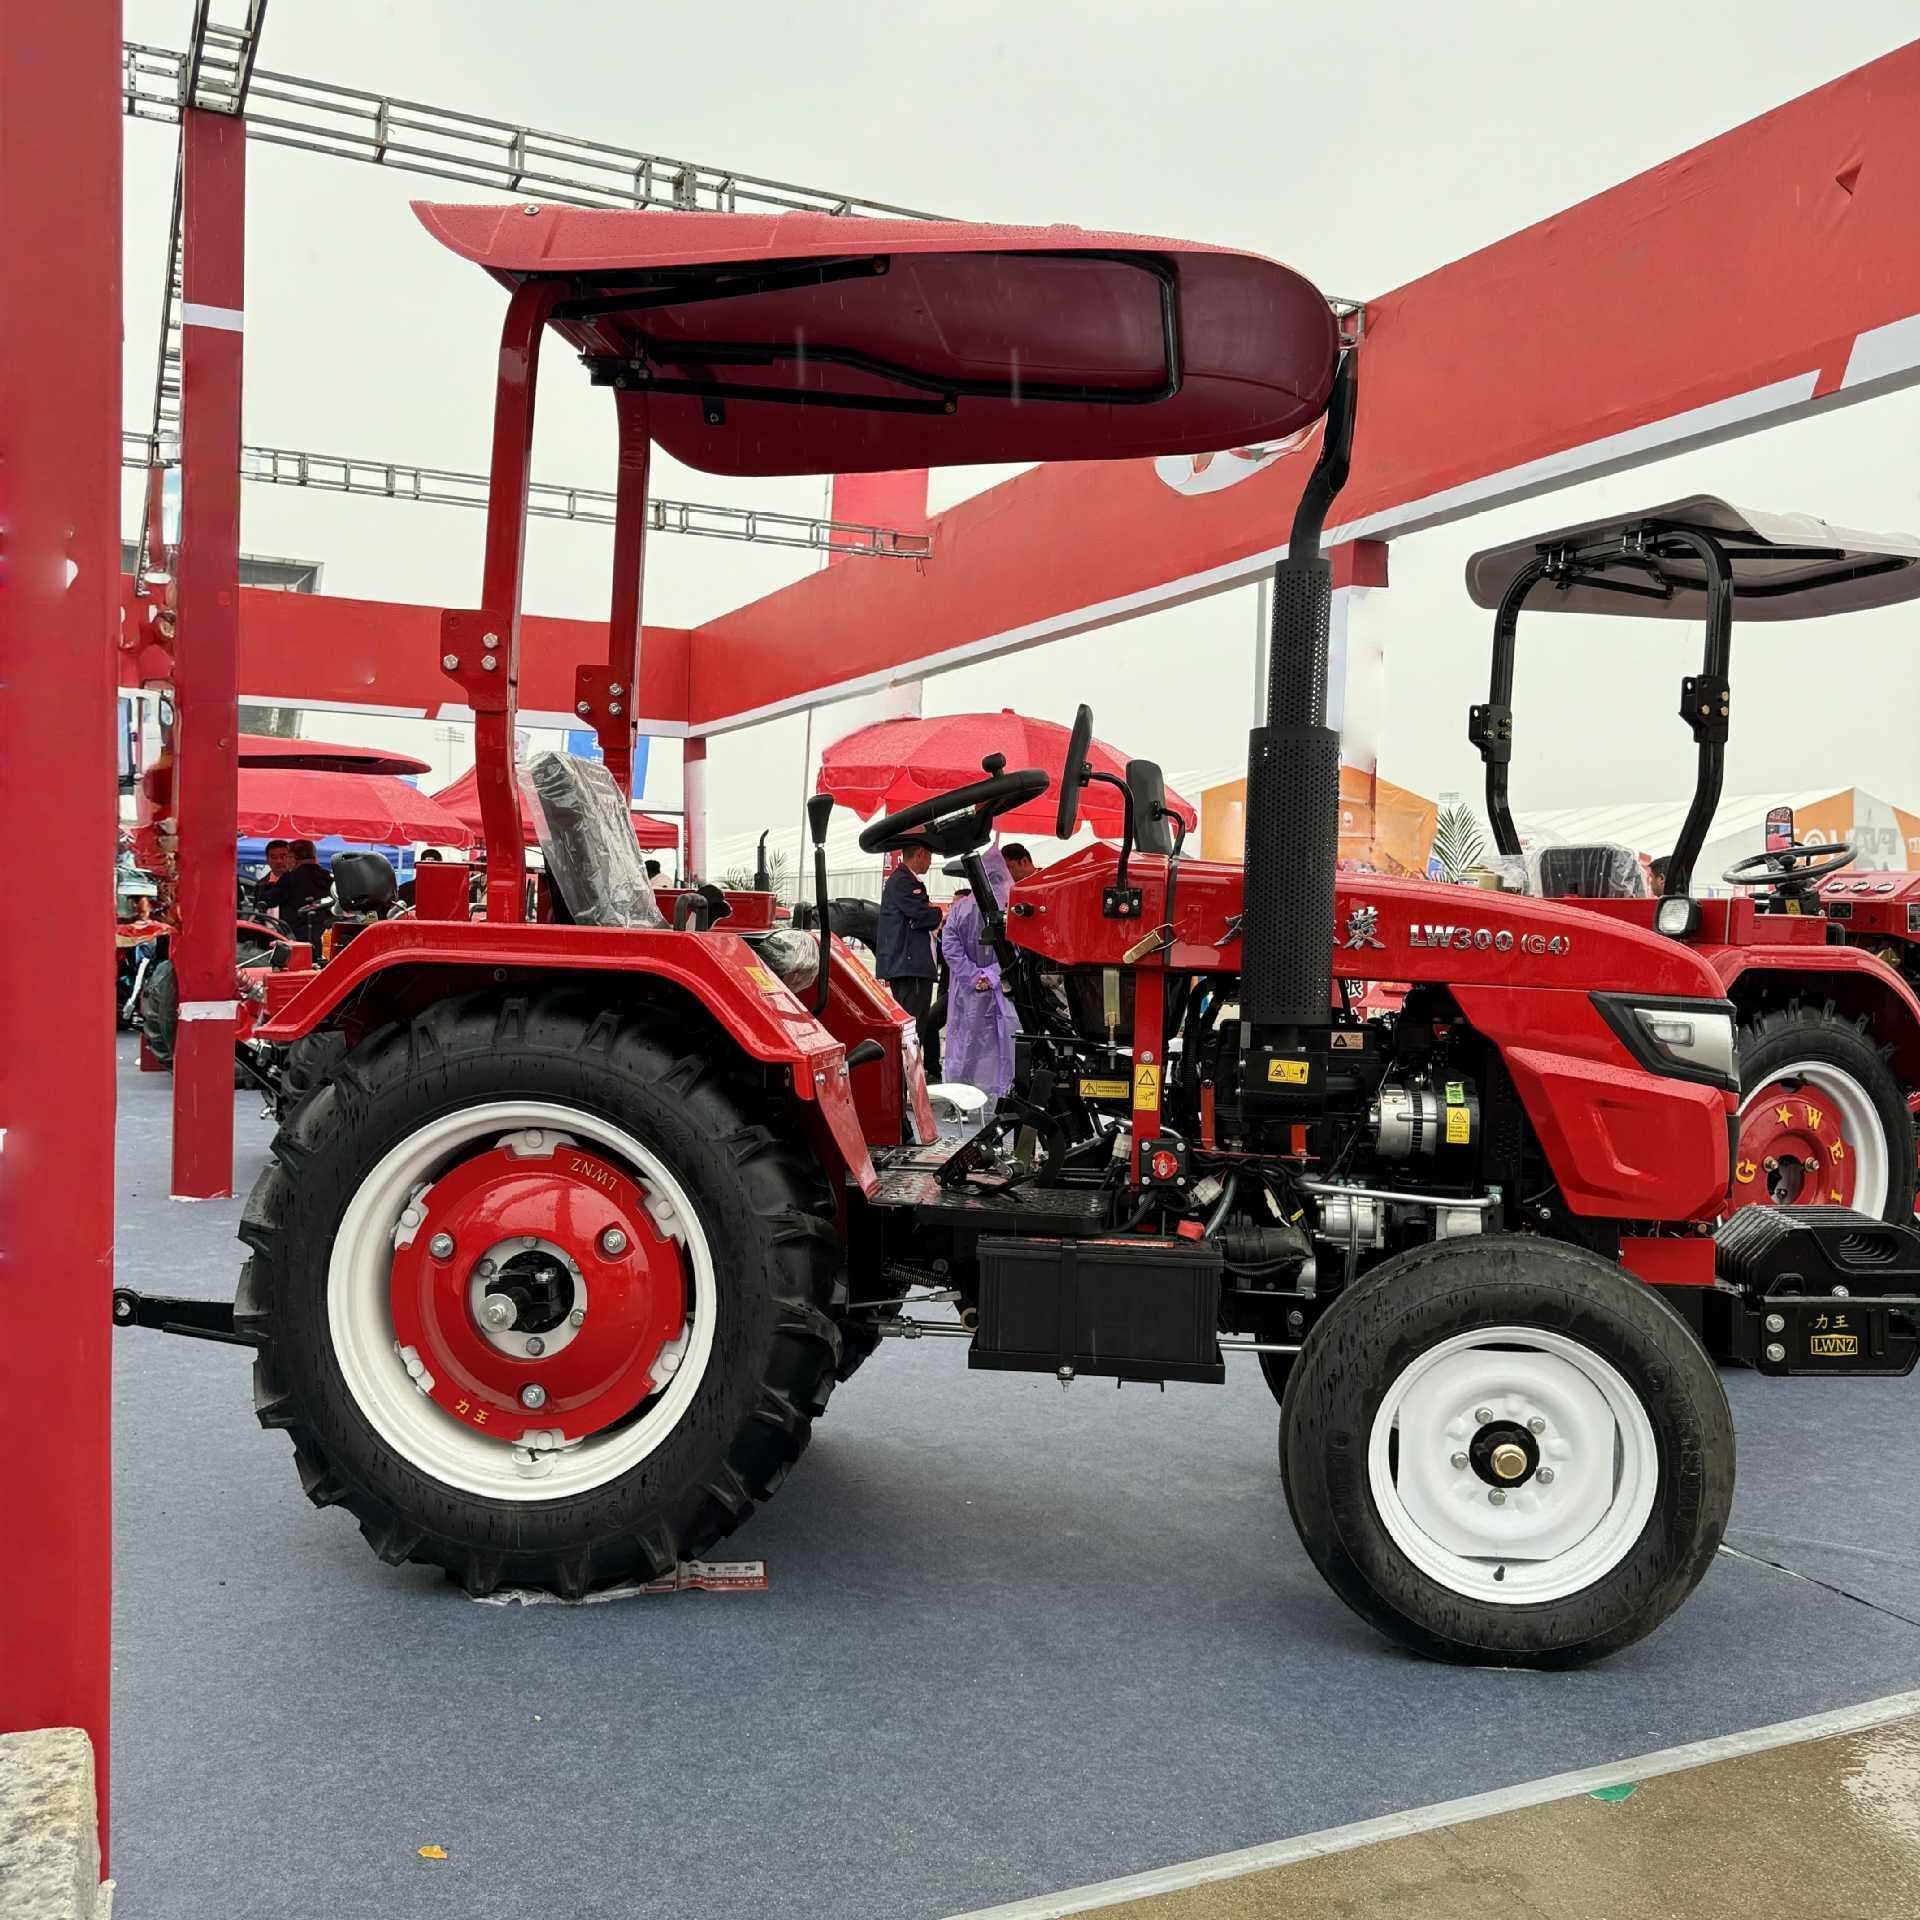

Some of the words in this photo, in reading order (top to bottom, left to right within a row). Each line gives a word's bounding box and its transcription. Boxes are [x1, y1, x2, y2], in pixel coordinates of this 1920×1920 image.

[1408, 923, 1515, 953] LW300
[1521, 933, 1571, 956] (G4)
[569, 1157, 618, 1191] LWNZ
[1814, 1313, 1850, 1330] 力王
[1814, 1338, 1855, 1353] LWNZ
[455, 1399, 490, 1425] 力王
